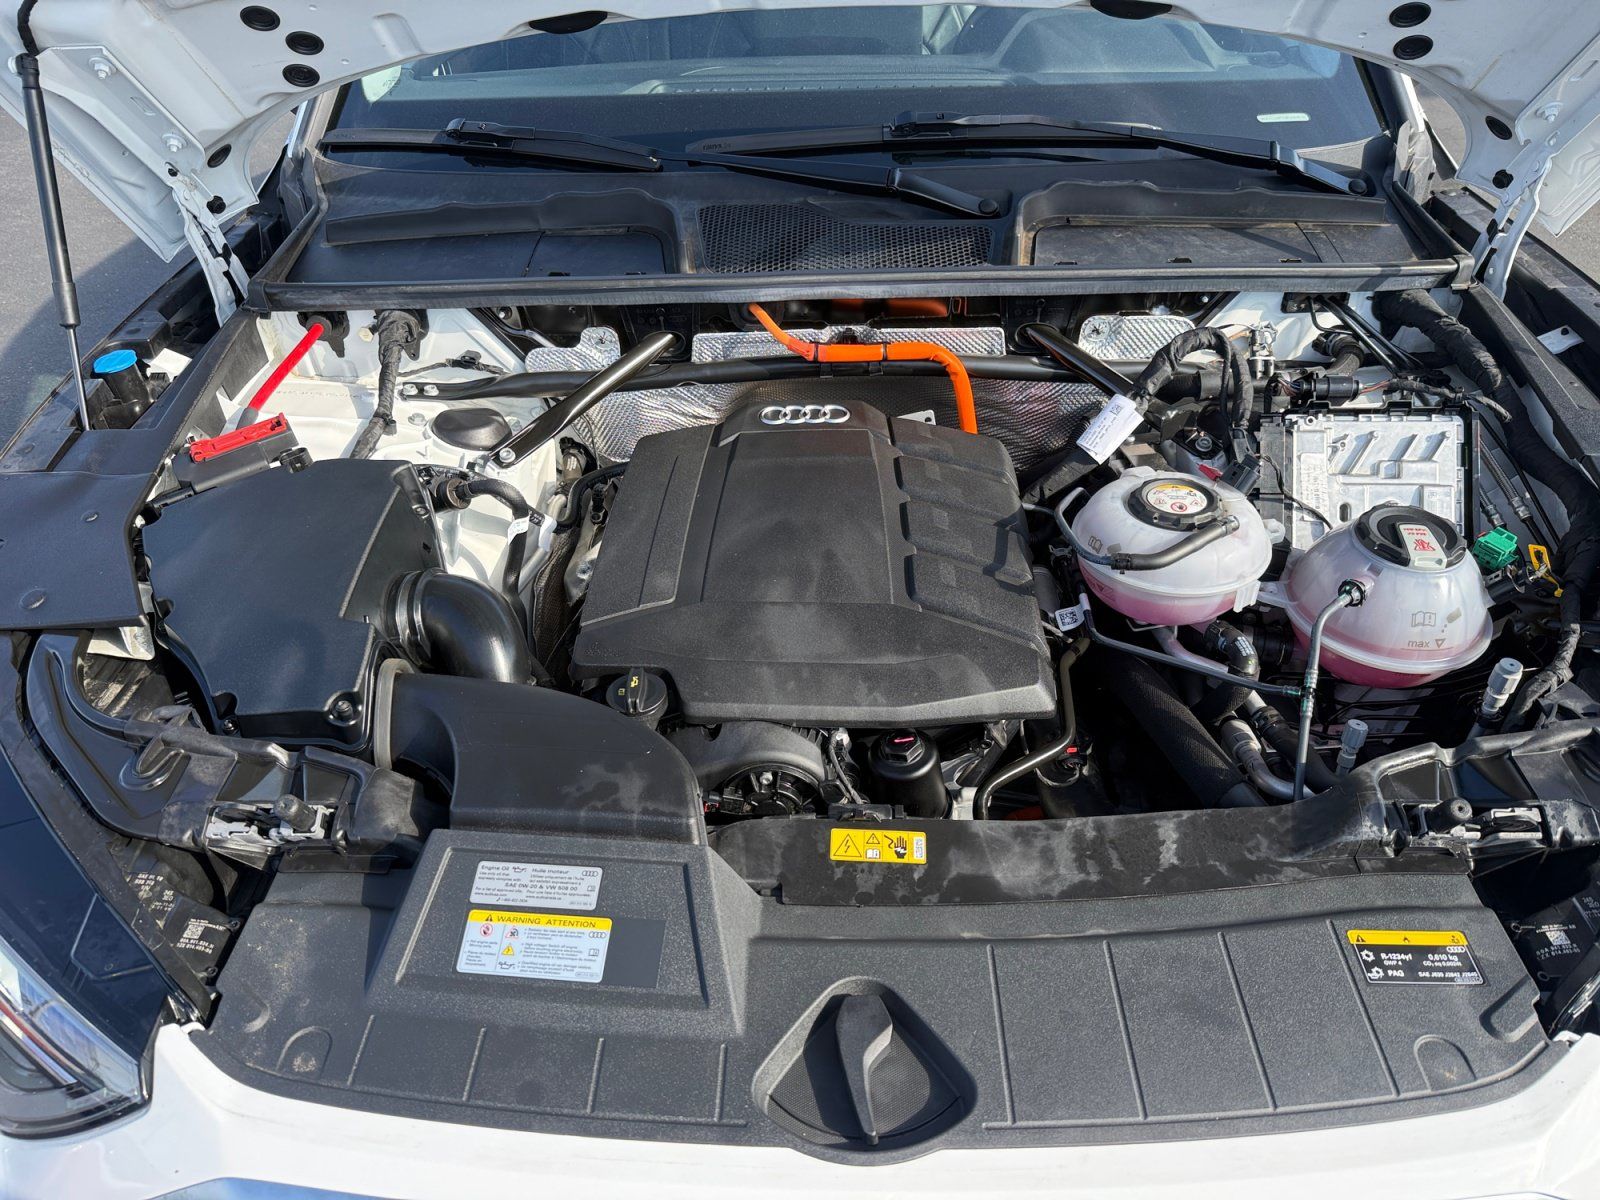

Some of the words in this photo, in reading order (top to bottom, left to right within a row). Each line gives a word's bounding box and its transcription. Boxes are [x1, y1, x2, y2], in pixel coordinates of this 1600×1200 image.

[1407, 639, 1430, 648] max
[497, 916, 541, 925] WARNING
[546, 919, 596, 928] ATTENTION
[1380, 952, 1412, 961] R-1234yf
[1448, 954, 1458, 962] kg
